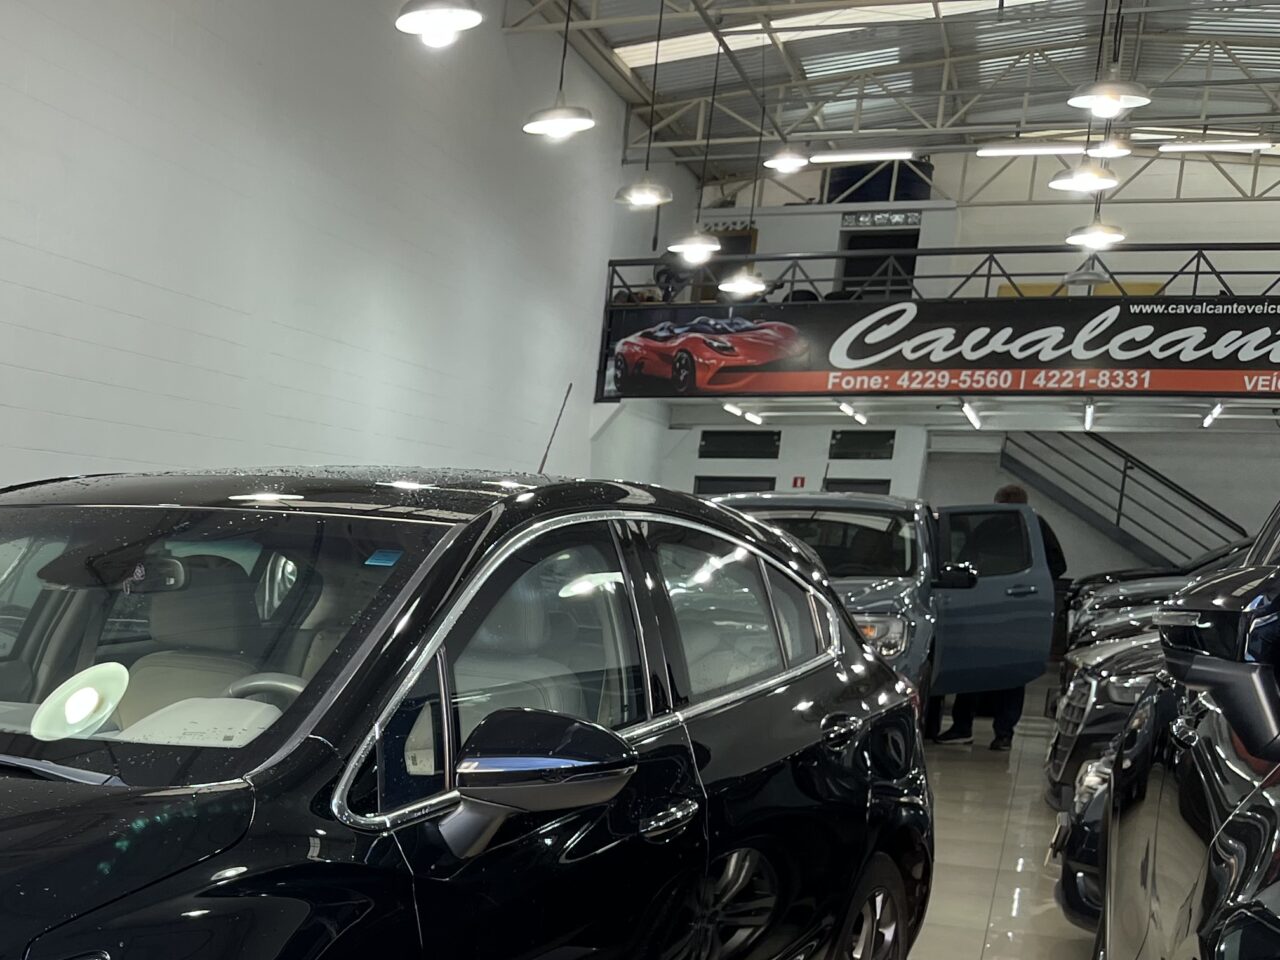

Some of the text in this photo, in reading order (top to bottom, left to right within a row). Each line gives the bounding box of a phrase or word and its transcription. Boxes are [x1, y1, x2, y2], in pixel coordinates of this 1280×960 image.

[827, 372, 890, 390] Fone:
[896, 370, 1013, 389] 4229-5560
[1032, 370, 1151, 389] 4221-8331
